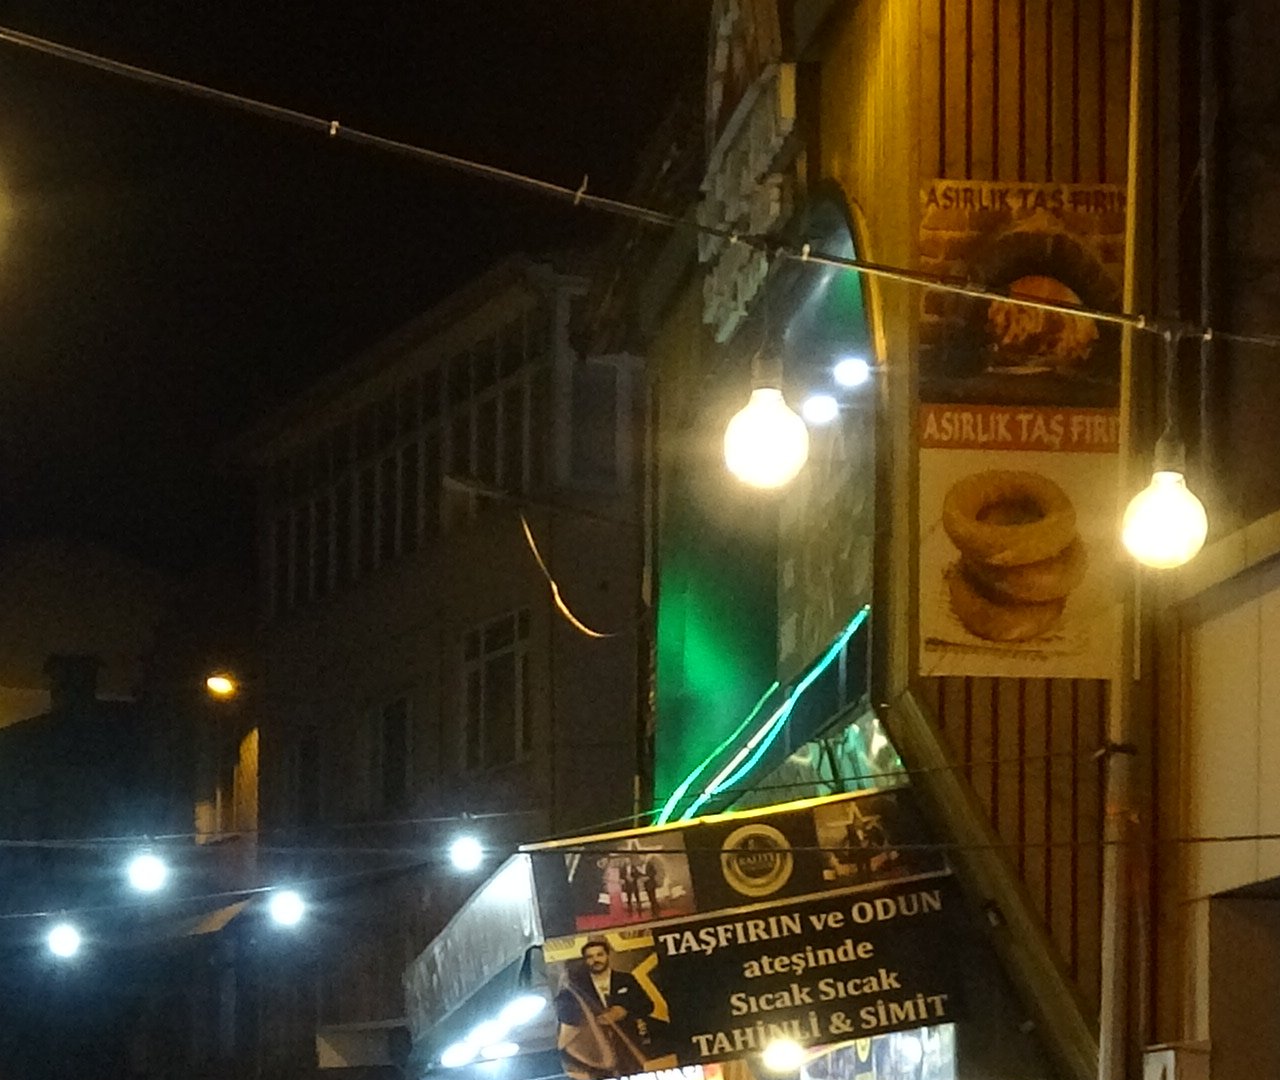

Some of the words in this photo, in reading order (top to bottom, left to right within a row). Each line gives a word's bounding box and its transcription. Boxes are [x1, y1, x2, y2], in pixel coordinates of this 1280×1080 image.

[923, 411, 1012, 442] ASIRLIK
[1016, 413, 1064, 449] TAŞ
[658, 912, 802, 956] TAŞFIRIN
[809, 911, 844, 931] ve
[851, 889, 943, 925] ODUN
[742, 938, 874, 979] ateşinde
[729, 982, 813, 1018] Sıcak
[818, 967, 902, 1001] Sıcak
[828, 1011, 854, 1036] &
[860, 993, 949, 1030] SİMİT
